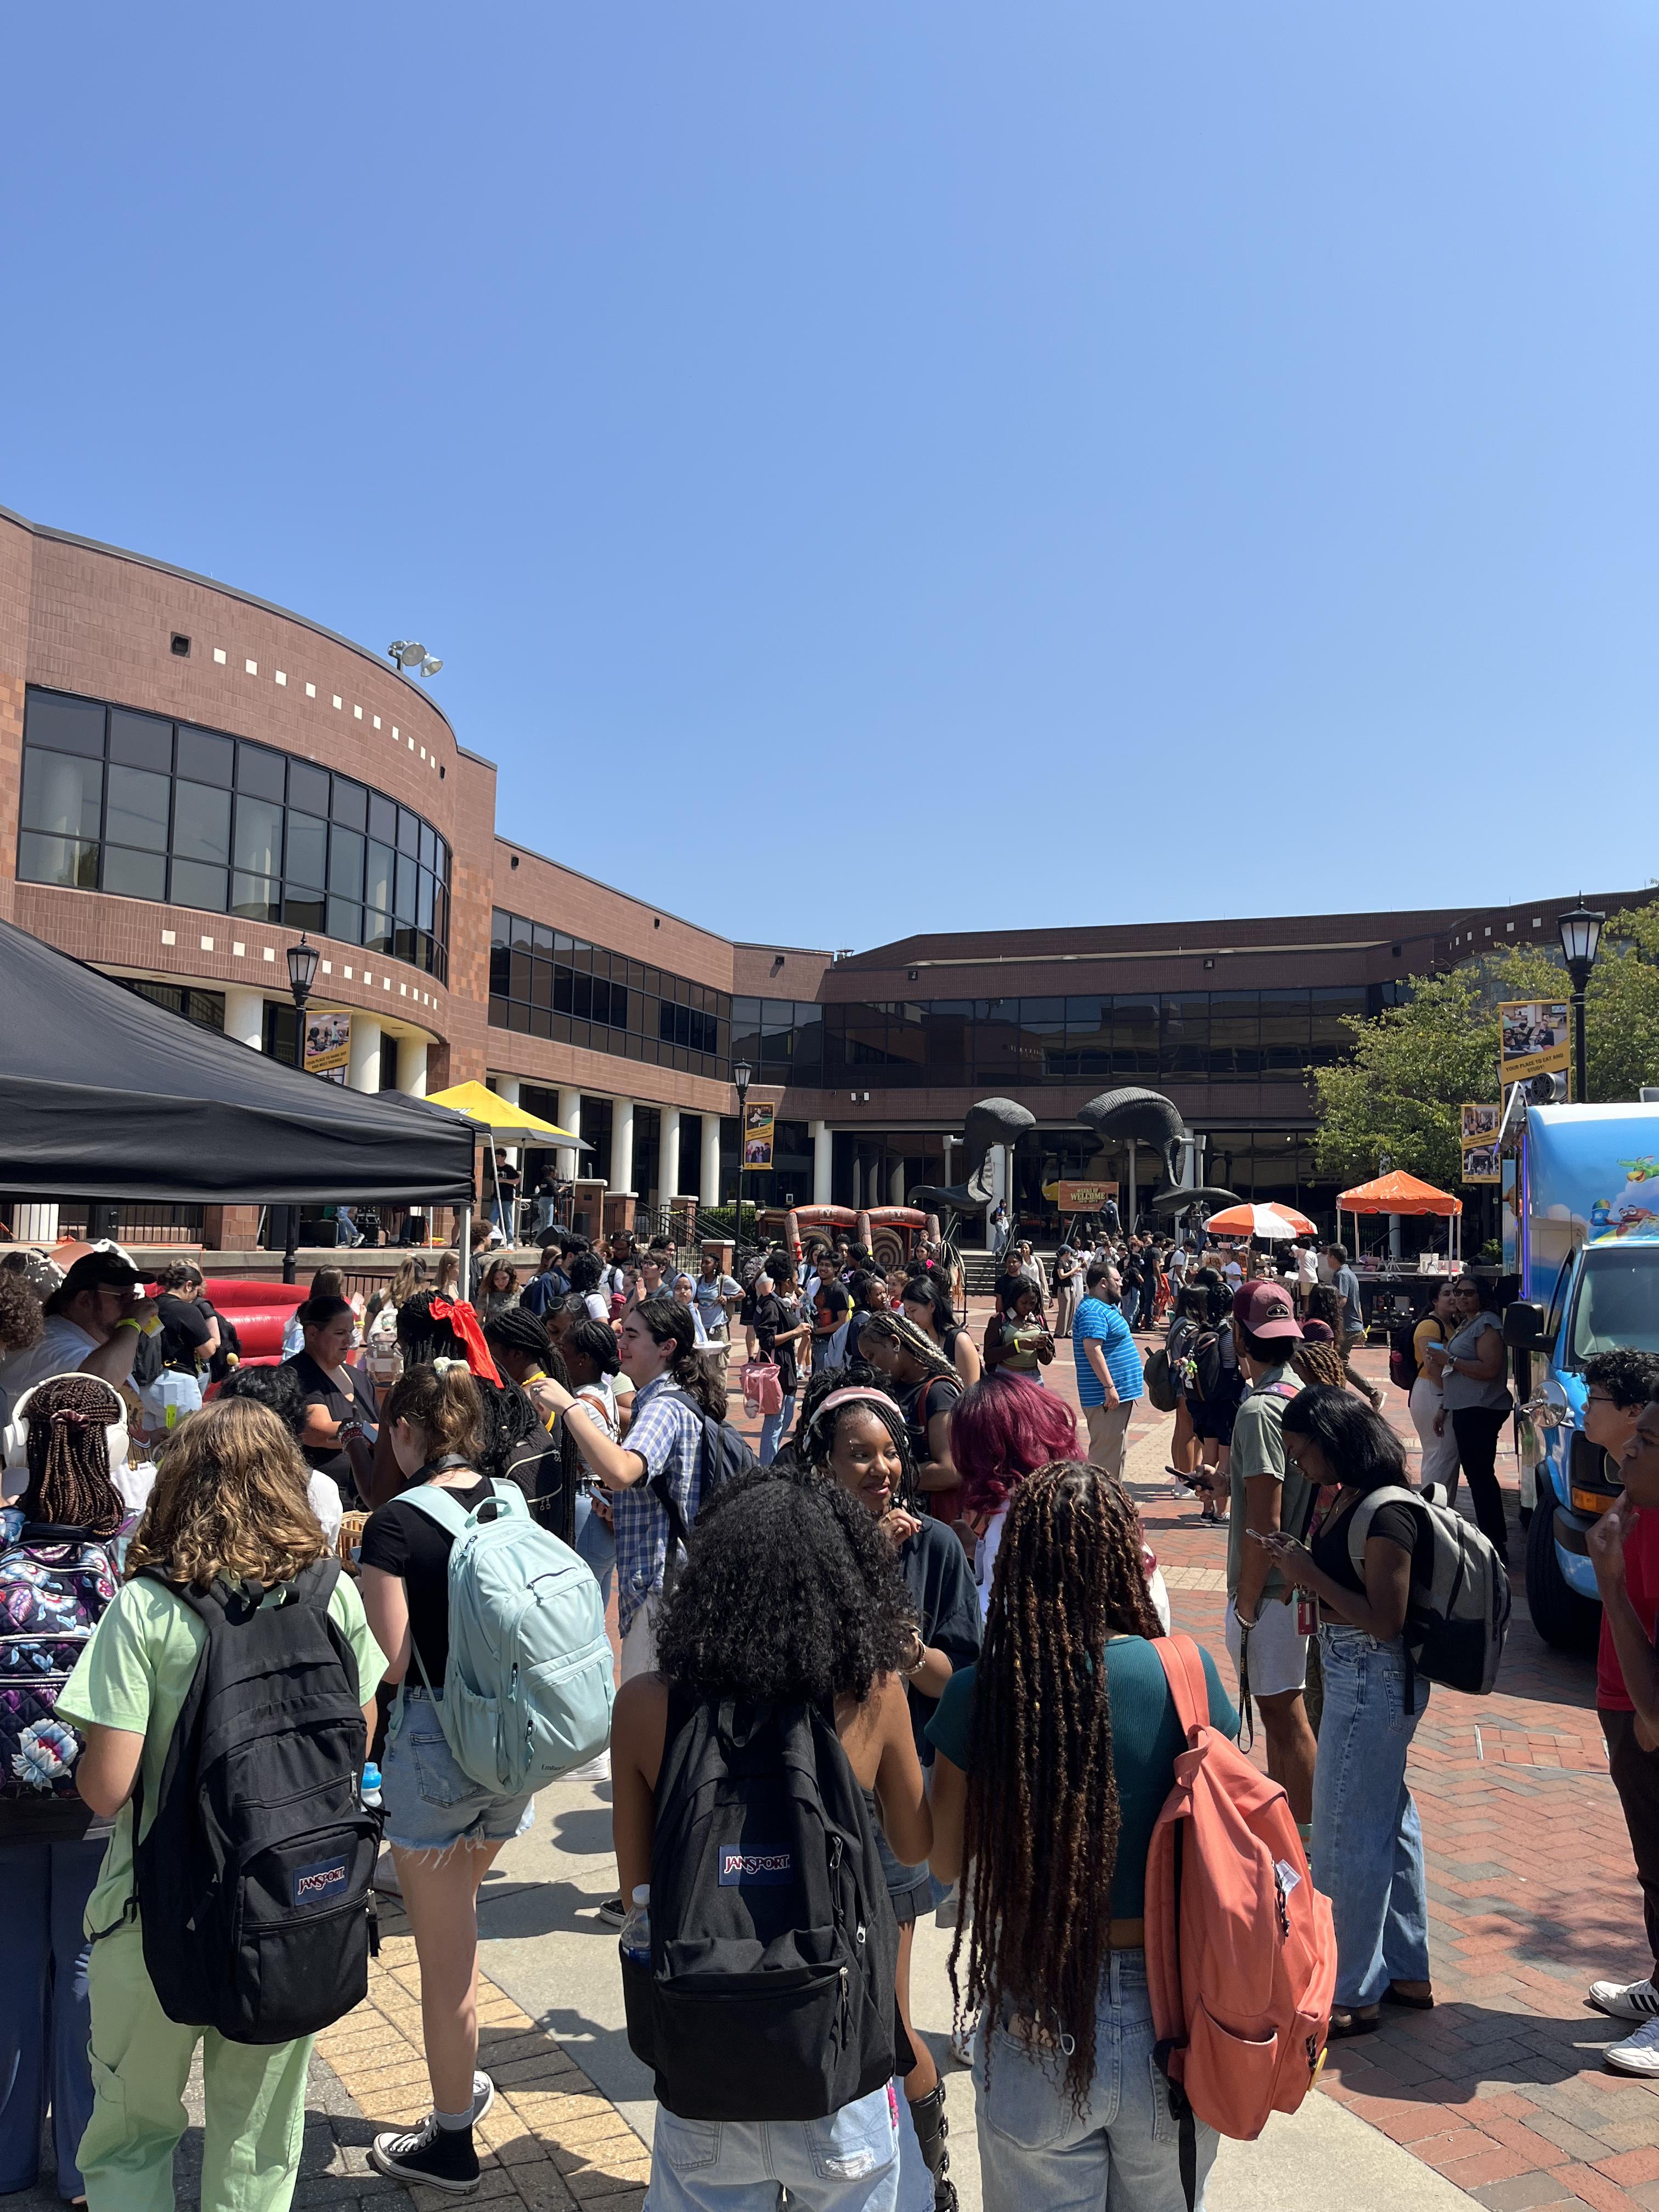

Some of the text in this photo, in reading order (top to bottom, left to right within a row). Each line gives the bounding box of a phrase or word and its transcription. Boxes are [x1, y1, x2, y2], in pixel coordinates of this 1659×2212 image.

[1070, 1192, 1106, 1200] WELCOME
[724, 1854, 789, 1874] JANSPORT
[297, 1866, 345, 1895] JANSPORT
